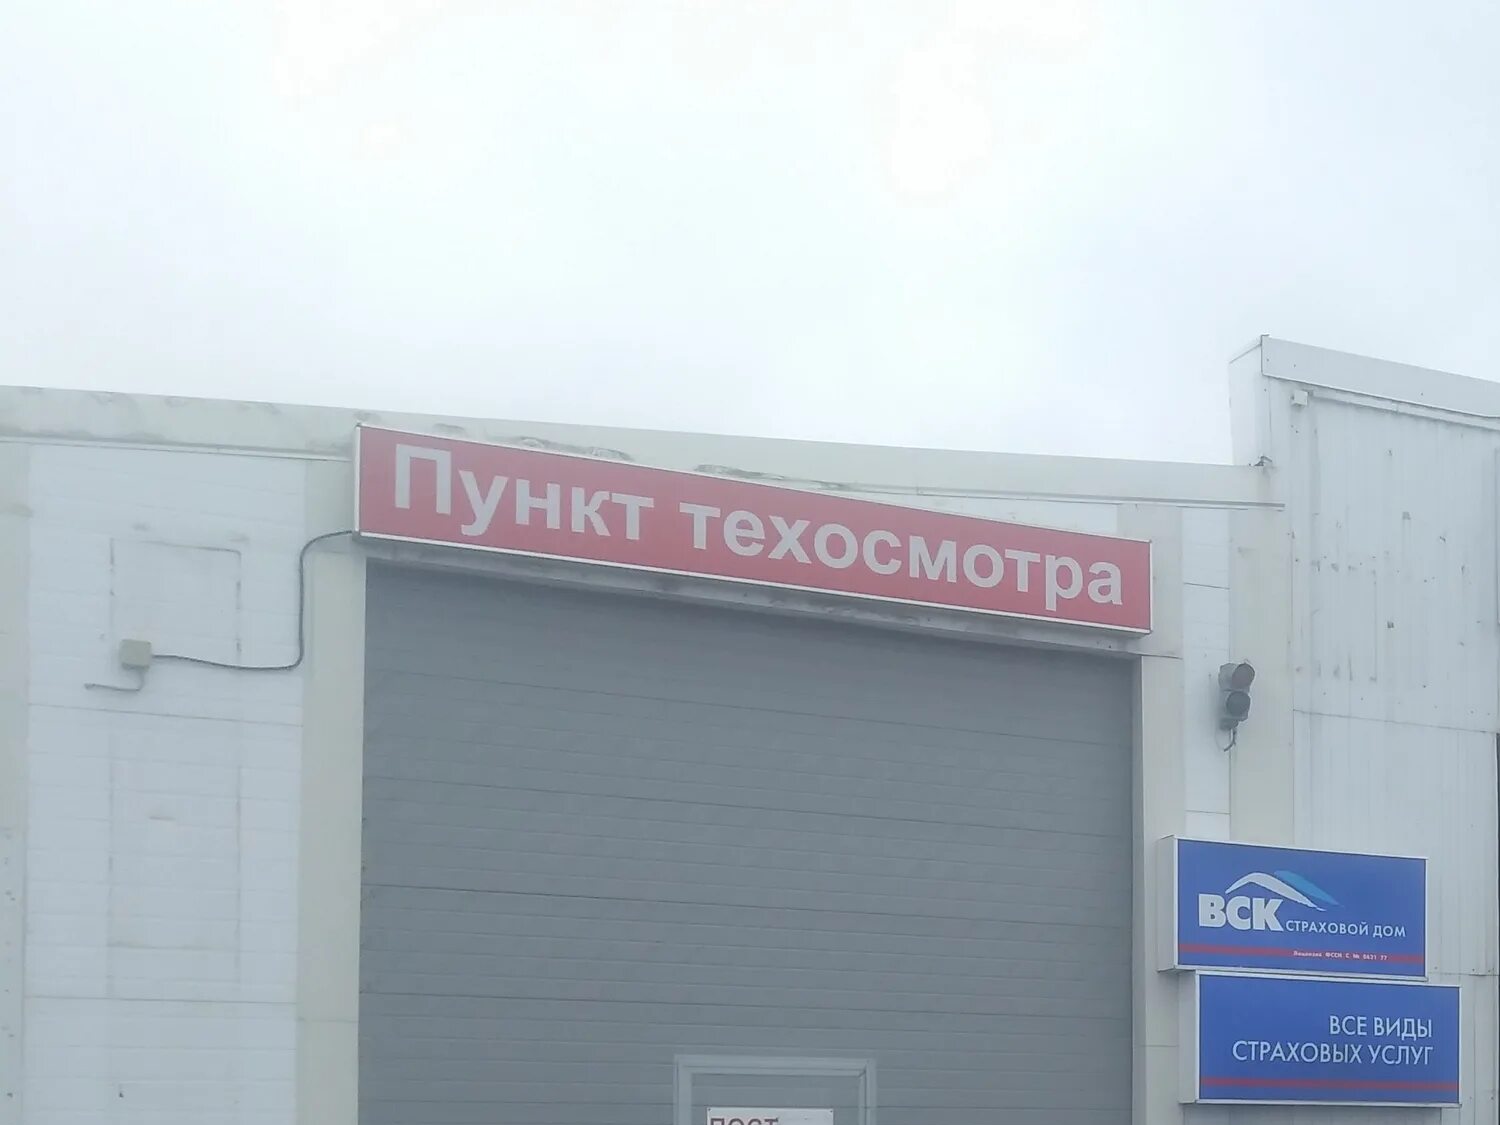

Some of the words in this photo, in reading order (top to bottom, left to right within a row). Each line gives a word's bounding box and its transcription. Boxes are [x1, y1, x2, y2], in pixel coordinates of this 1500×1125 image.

[393, 443, 654, 540] Пункт
[679, 504, 1124, 611] техосмотра
[1198, 893, 1285, 932] ВСК
[1285, 920, 1369, 936] СТРАХОВОЙ
[1373, 925, 1406, 939] ДОМ
[1329, 1015, 1367, 1036] ВСЕ
[1373, 1017, 1433, 1041] ВИДЫ
[1232, 1040, 1363, 1064] СТРАХОВЫХ
[1367, 1045, 1434, 1066] УСЛУГ
